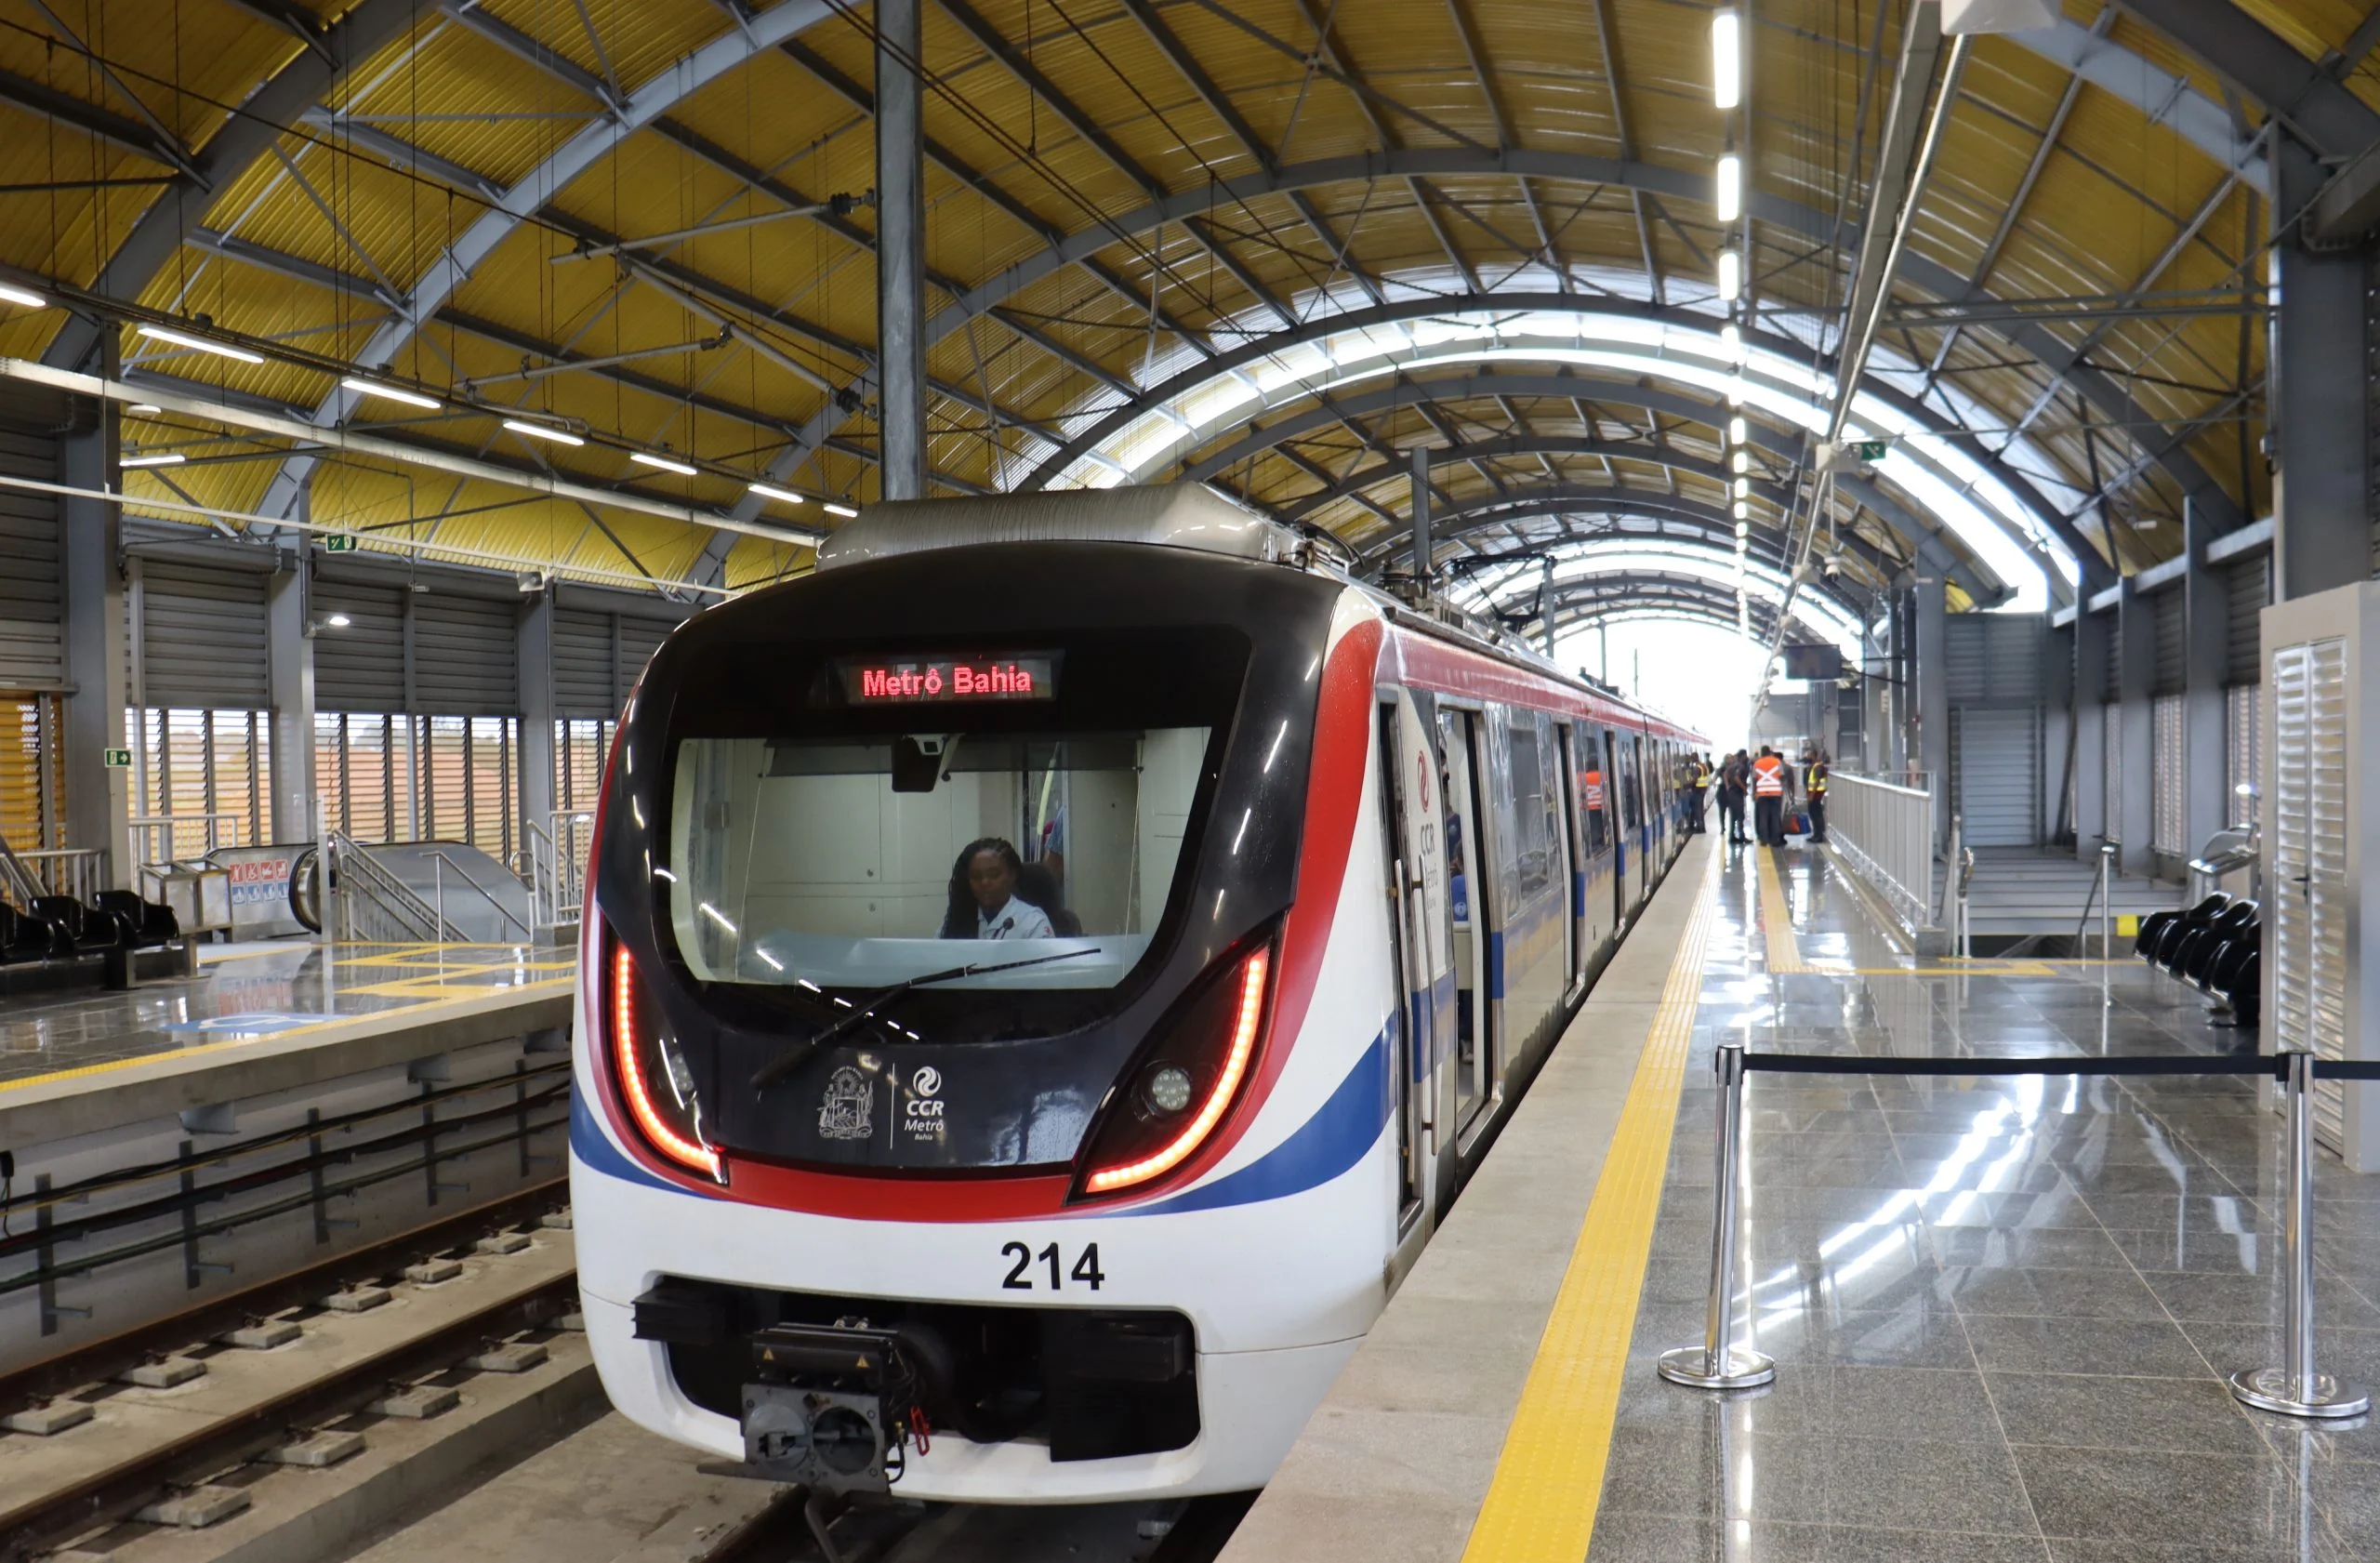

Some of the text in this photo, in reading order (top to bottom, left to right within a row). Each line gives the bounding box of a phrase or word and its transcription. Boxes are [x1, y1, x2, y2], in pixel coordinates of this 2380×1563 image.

[863, 665, 1031, 696] Metrô Bahia
[1421, 823, 1435, 854] CCR
[906, 1100, 945, 1116] CCR
[904, 1119, 944, 1132] Metrô
[914, 1133, 933, 1141] Bahia
[1001, 1241, 1104, 1291] 214
